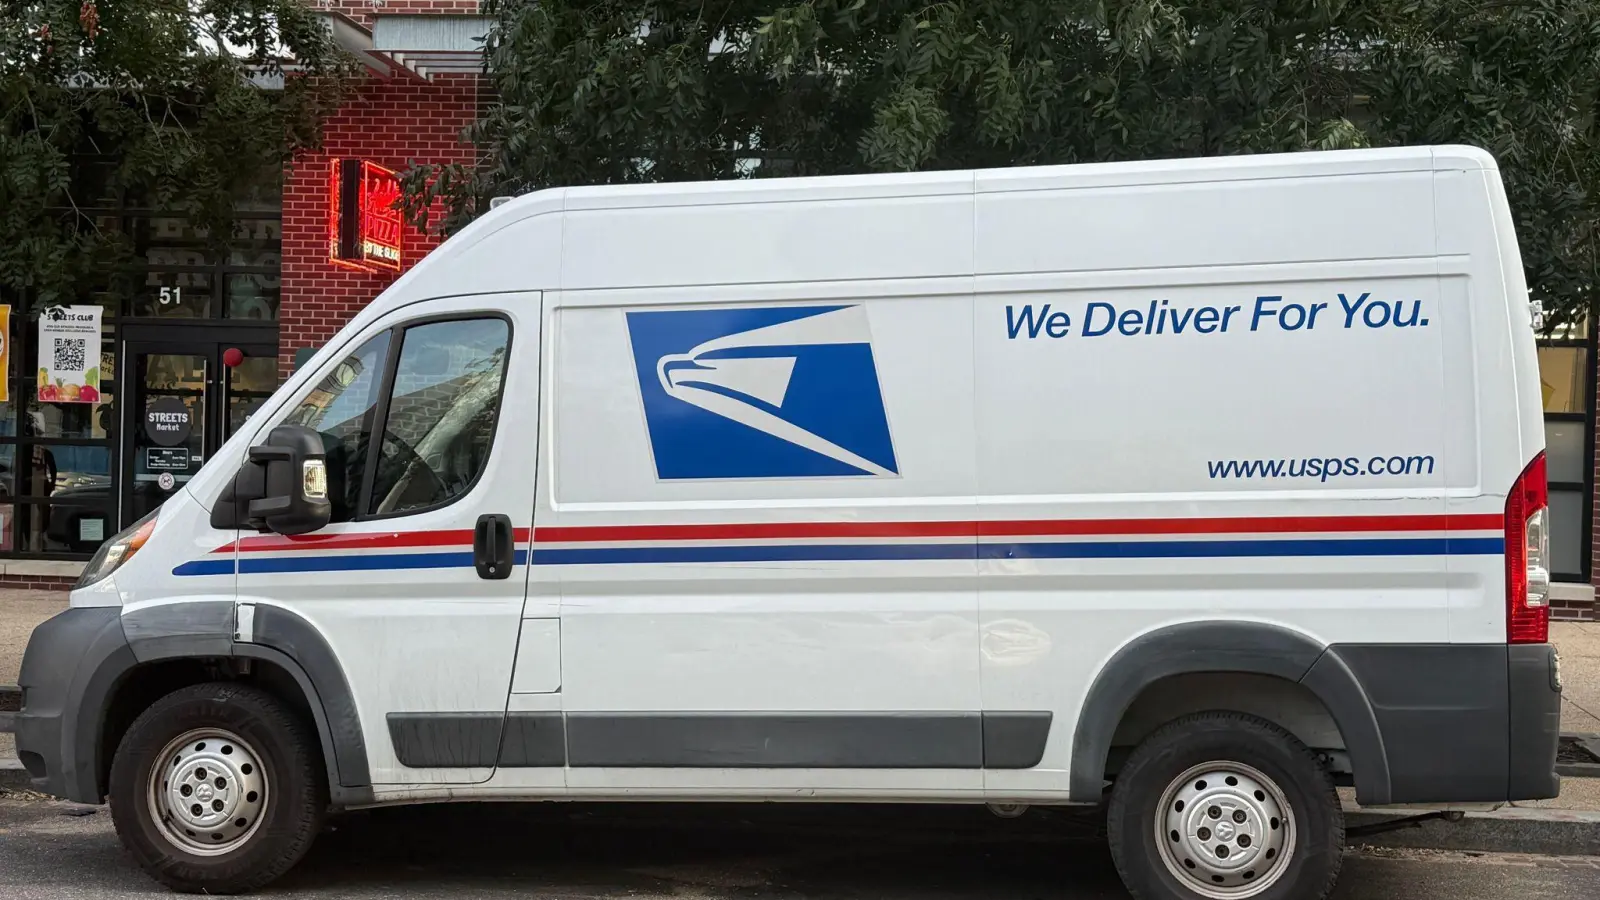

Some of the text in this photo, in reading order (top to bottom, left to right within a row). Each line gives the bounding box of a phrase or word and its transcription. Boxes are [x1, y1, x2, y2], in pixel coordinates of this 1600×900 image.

[366, 215, 399, 246] PIZZA
[373, 243, 384, 258] THE
[159, 286, 181, 305] 51
[1005, 292, 1430, 340] We Deliver For You.
[148, 412, 188, 423] STREETS
[156, 423, 180, 431] Market
[1208, 454, 1435, 483] www.usps.com
